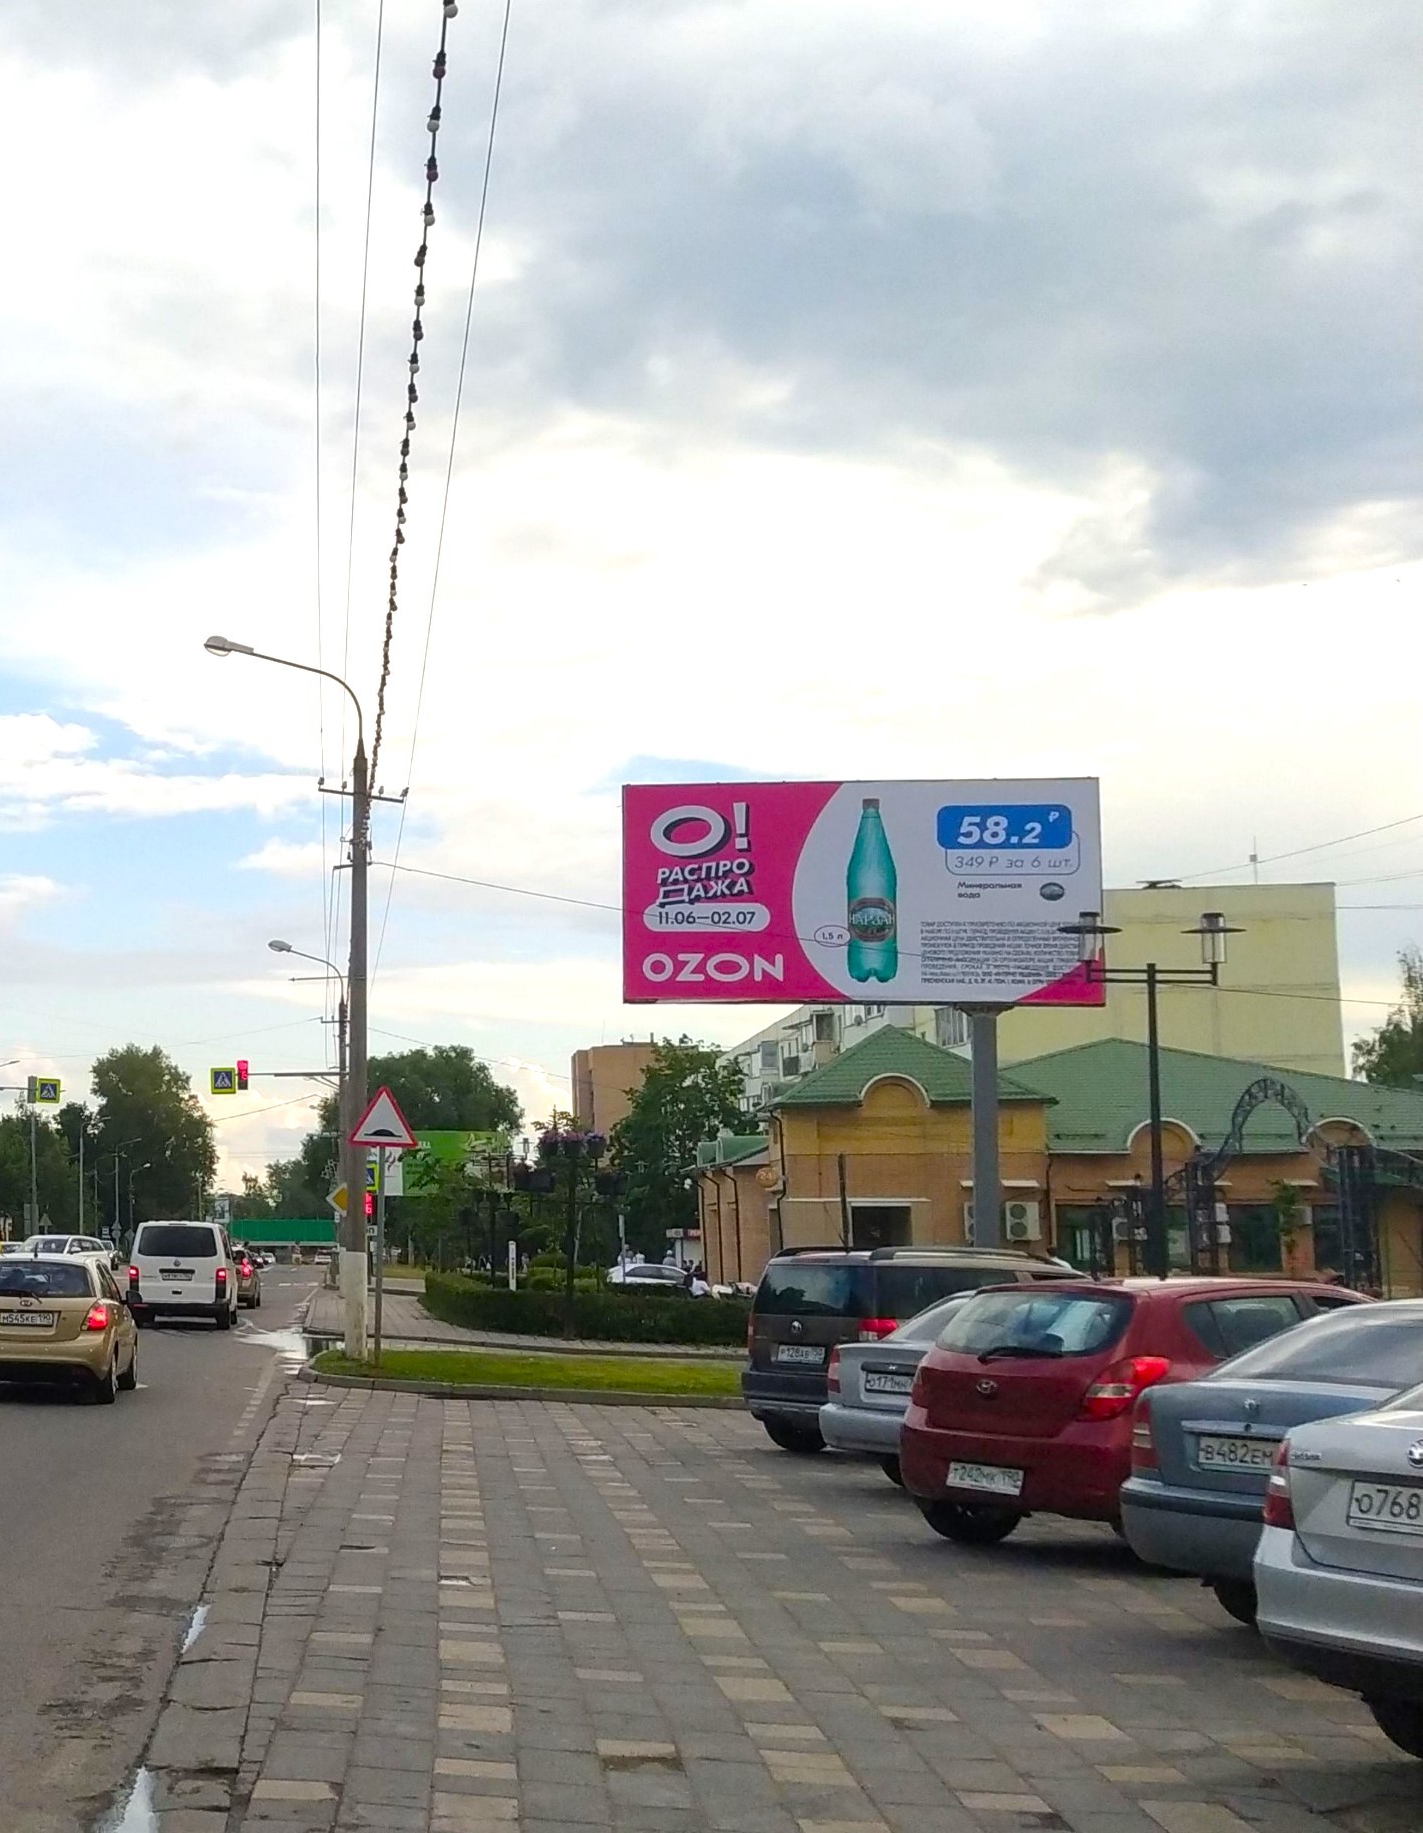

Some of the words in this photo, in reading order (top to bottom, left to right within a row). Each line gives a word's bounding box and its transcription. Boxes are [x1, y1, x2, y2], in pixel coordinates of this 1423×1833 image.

[957, 815, 1042, 845] 58.2
[656, 858, 751, 884] РАСПРО
[955, 856, 985, 869] 349
[1005, 858, 1024, 869] за
[1031, 856, 1042, 868] 6
[1048, 858, 1074, 868] шт.
[656, 877, 750, 906] ДАЖА
[957, 881, 1022, 891] Минеральная
[957, 892, 981, 900] вода
[642, 952, 784, 982] OZON
